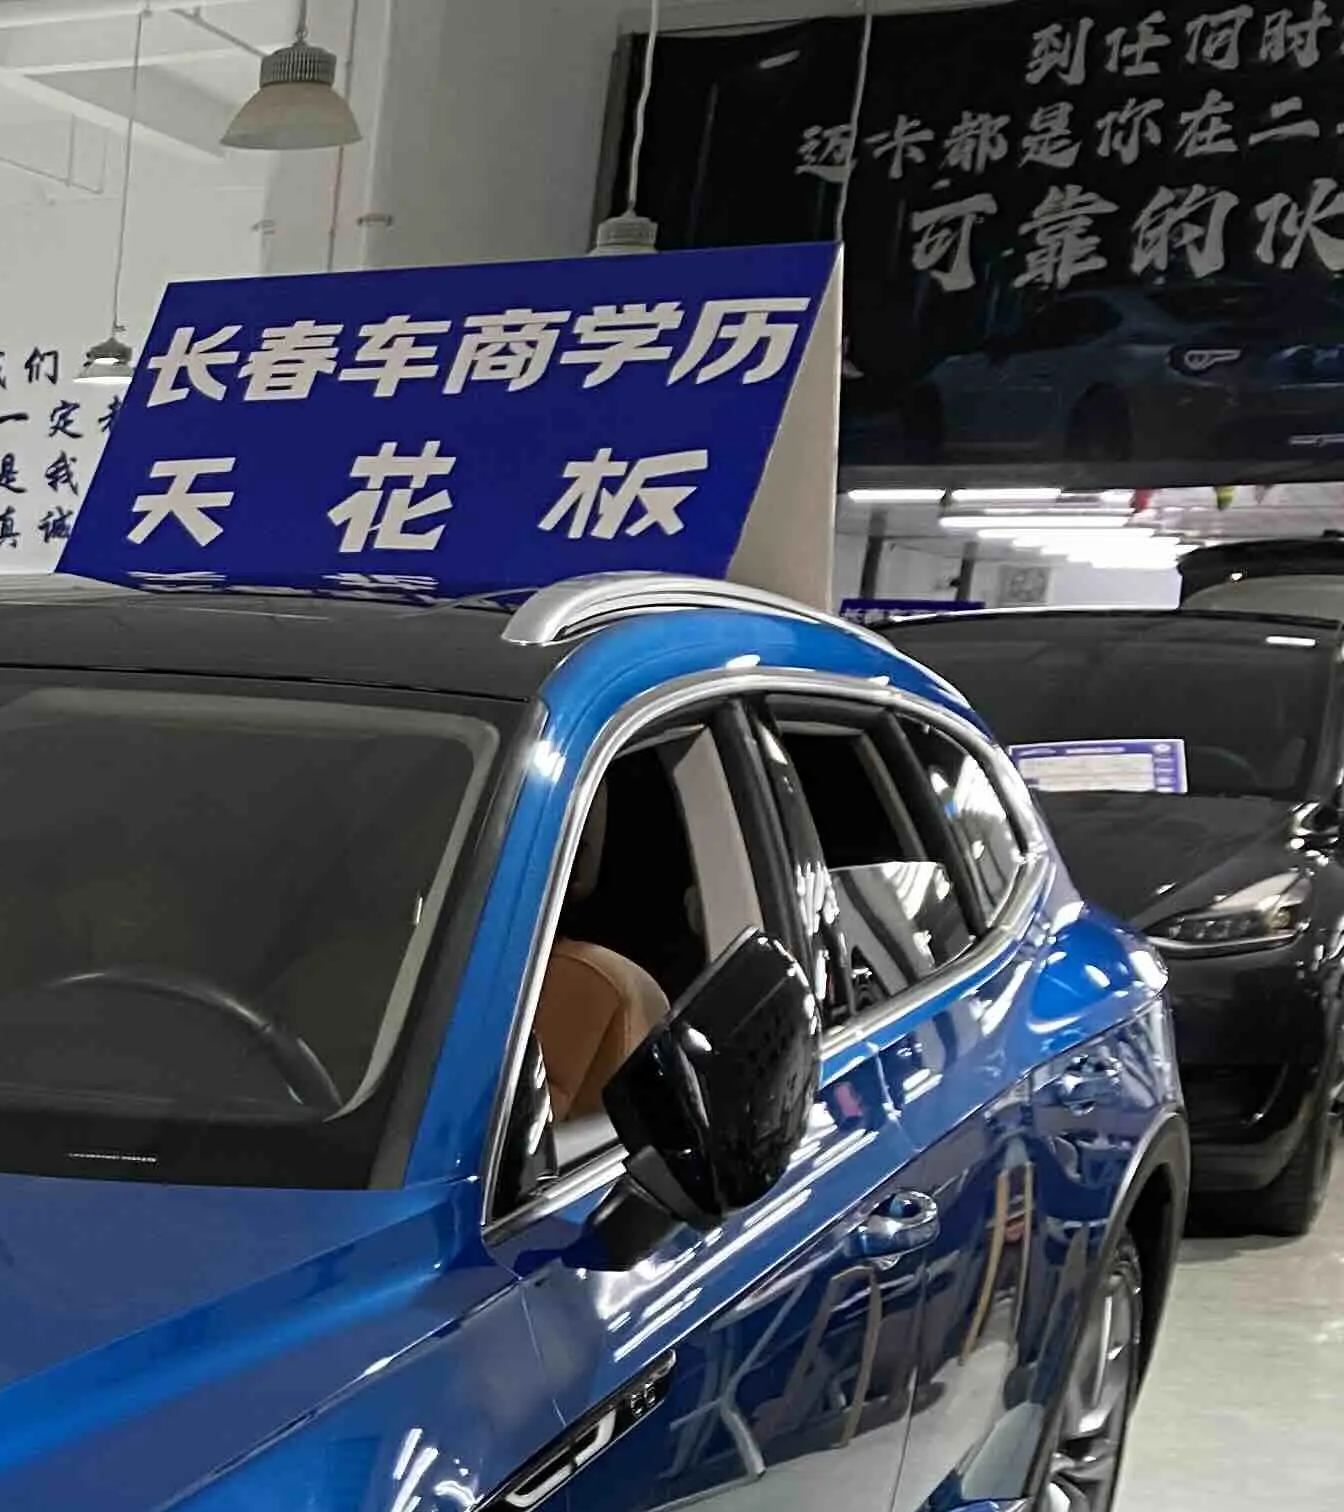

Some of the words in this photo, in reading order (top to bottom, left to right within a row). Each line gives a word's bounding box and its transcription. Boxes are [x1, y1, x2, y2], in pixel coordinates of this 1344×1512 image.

[1025, 0, 1344, 86] 到任何时
[795, 88, 1344, 183] 迈卡都是你在二
[147, 296, 811, 410] 长春车商学历
[127, 440, 709, 554] 天花板
